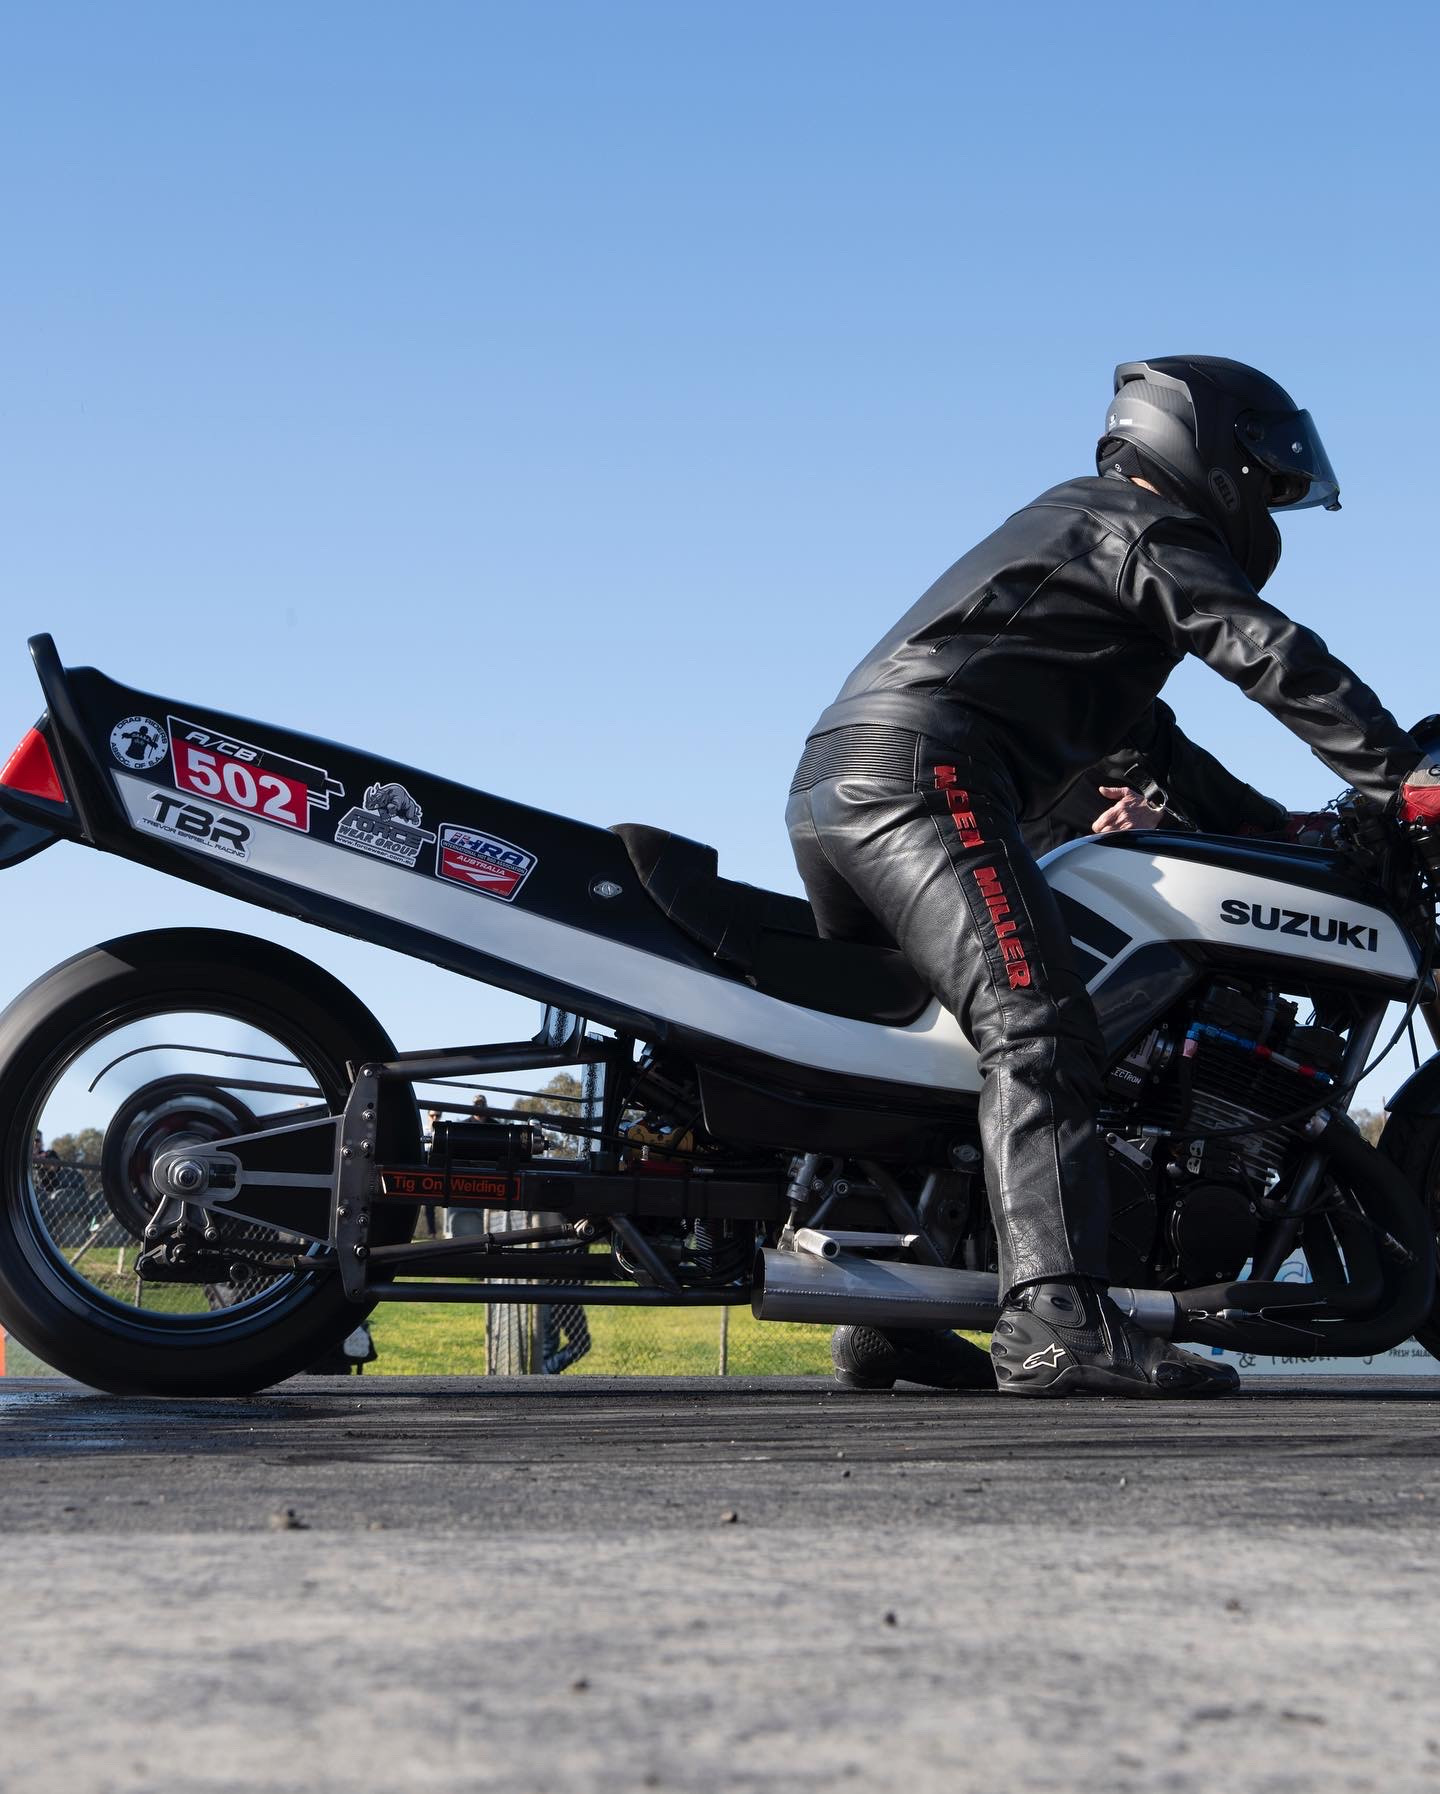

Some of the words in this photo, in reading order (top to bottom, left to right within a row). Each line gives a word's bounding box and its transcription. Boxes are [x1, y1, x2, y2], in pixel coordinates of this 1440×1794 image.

[1214, 474, 1235, 509] BELL
[117, 717, 141, 729] DRAG
[145, 719, 168, 744] RIDERS
[185, 731, 257, 762] A/CB
[187, 747, 297, 823] 502
[142, 817, 176, 834] TREVOR
[177, 831, 213, 847] BIRRELL
[214, 844, 246, 858] RACING
[151, 794, 250, 852] TBR
[341, 809, 425, 850] FORCE
[339, 825, 374, 843] WEAR
[375, 838, 418, 857] GROUP
[442, 841, 477, 857] INTERNATIONAL
[497, 860, 526, 873] ASSOCIATION
[457, 855, 505, 875] AUSTRALIA
[973, 866, 1031, 989] MILLER
[1220, 899, 1378, 952] SUZUKI
[1111, 1067, 1142, 1085] ECTRON
[394, 1176, 415, 1192] Tig
[422, 1177, 443, 1190] On
[450, 1178, 506, 1196] Welding
